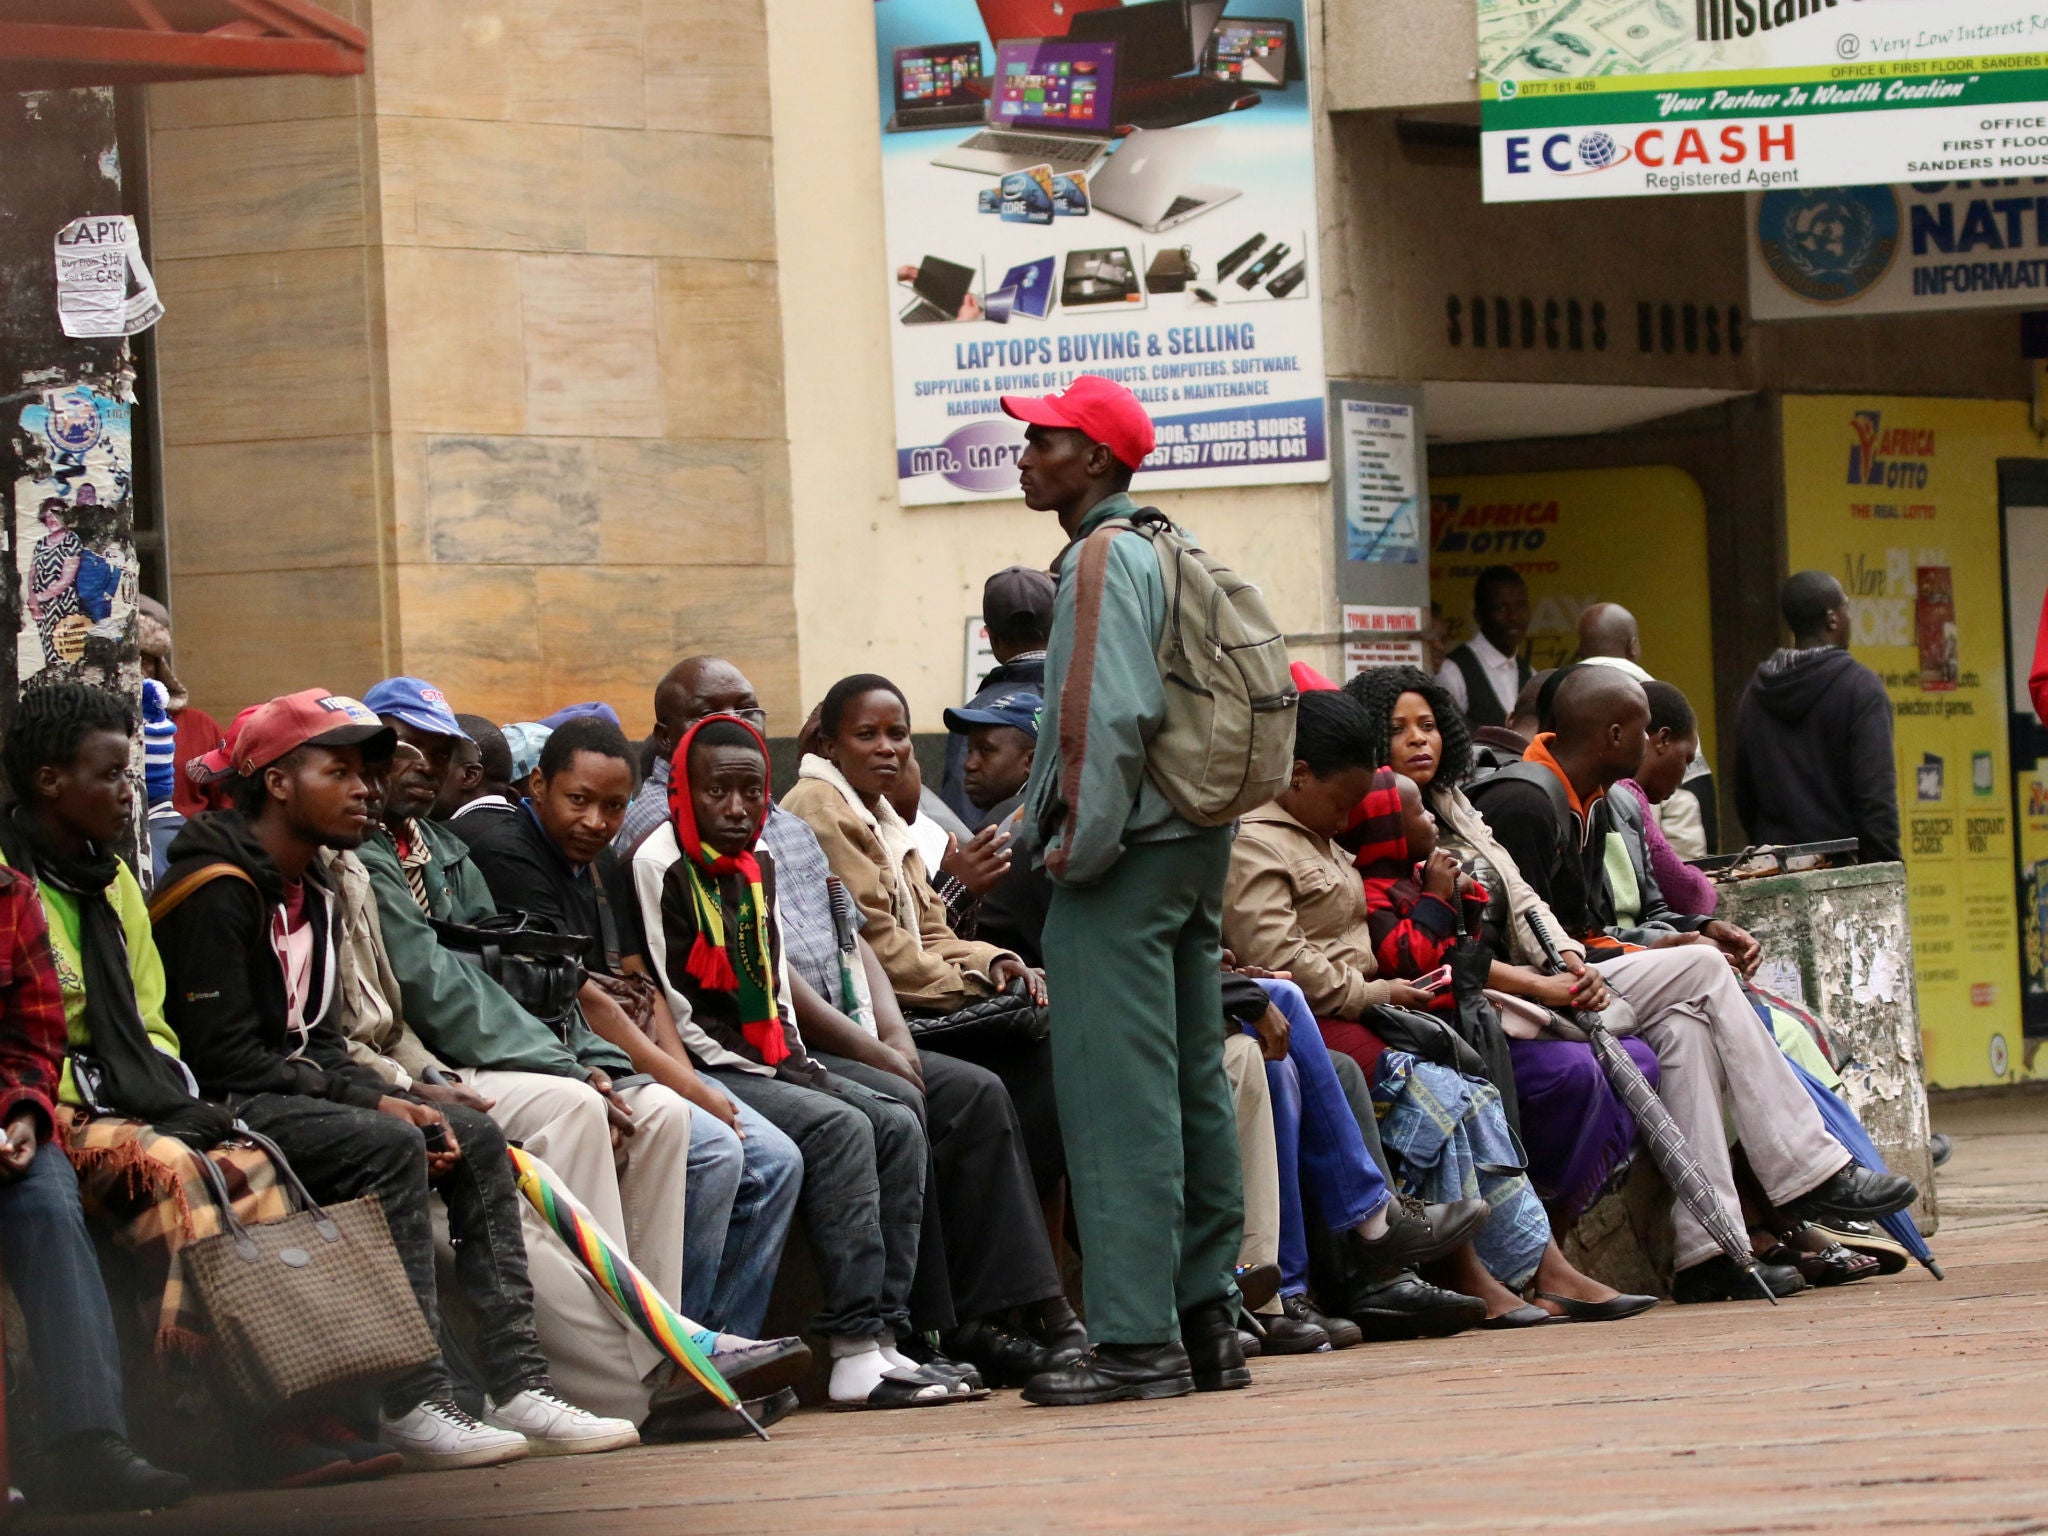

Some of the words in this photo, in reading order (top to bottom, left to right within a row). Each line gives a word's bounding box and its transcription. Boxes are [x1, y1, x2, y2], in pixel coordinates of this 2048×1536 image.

[1837, 33, 1860, 59] @
[1870, 36, 1911, 59] Very
[1916, 29, 1954, 48] Low
[1957, 17, 2025, 41] Interest
[1831, 63, 1875, 78] OFFICE
[1893, 62, 1927, 74] FIRST
[1981, 55, 2041, 70] SANDERS
[1522, 82, 1548, 95] 0777
[1553, 81, 1572, 93] 181
[1709, 88, 1780, 111] Partner
[1783, 86, 1807, 108] In
[1811, 80, 1881, 106] Wealth
[1980, 116, 2046, 131] OFFICE
[1942, 138, 1996, 152] FIRST
[1907, 157, 1993, 172] SANDERS
[1645, 170, 1742, 190] Registered
[1746, 168, 1799, 186] Agent
[956, 336, 1053, 370] LAPTOPS
[1057, 330, 1141, 363] BUYING
[1147, 333, 1162, 357] &
[1168, 322, 1256, 355] SELLING
[983, 378, 992, 392] &
[994, 374, 1040, 391] BUYING
[1042, 371, 1057, 388] OF
[946, 398, 1002, 416] HARDWA
[1134, 386, 1169, 403] SALES
[1172, 387, 1180, 401] &
[1183, 380, 1270, 400] MAINTENANCE
[1190, 419, 1256, 443] SANDERS
[1257, 416, 1307, 437] HOUSE
[1173, 443, 1201, 465] 957
[1202, 442, 1210, 462] /
[1211, 440, 1248, 462] 0772
[1280, 437, 1308, 458] 041
[1879, 427, 1936, 458] AFRICA
[912, 446, 961, 474] MR.
[966, 444, 1022, 469] LAPT
[1459, 501, 1560, 528] AFRICA
[1851, 504, 1872, 519] THE
[1873, 504, 1899, 519] REAL
[1902, 504, 1937, 520] LOTTO
[1911, 818, 1954, 837] SCRATCH
